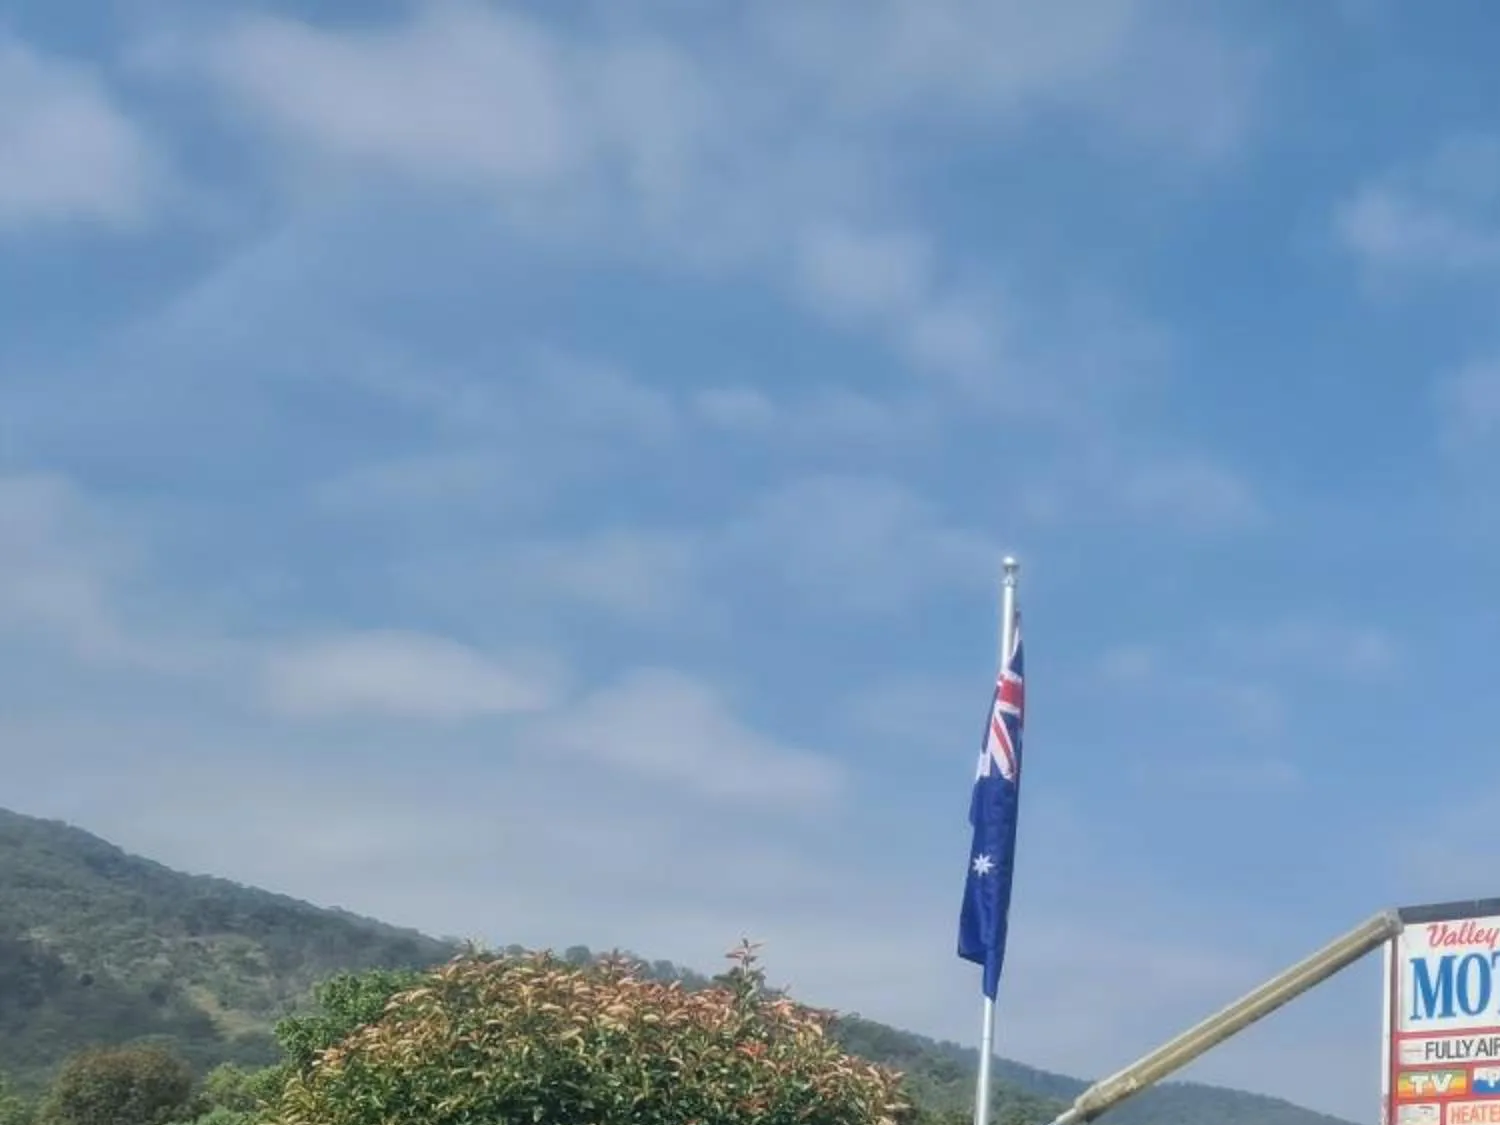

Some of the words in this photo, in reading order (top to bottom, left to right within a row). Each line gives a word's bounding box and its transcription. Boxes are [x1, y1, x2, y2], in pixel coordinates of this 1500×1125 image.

[1427, 921, 1500, 948] Valley
[1425, 1038, 1474, 1060] FULLY
[1410, 1072, 1453, 1095] TV
